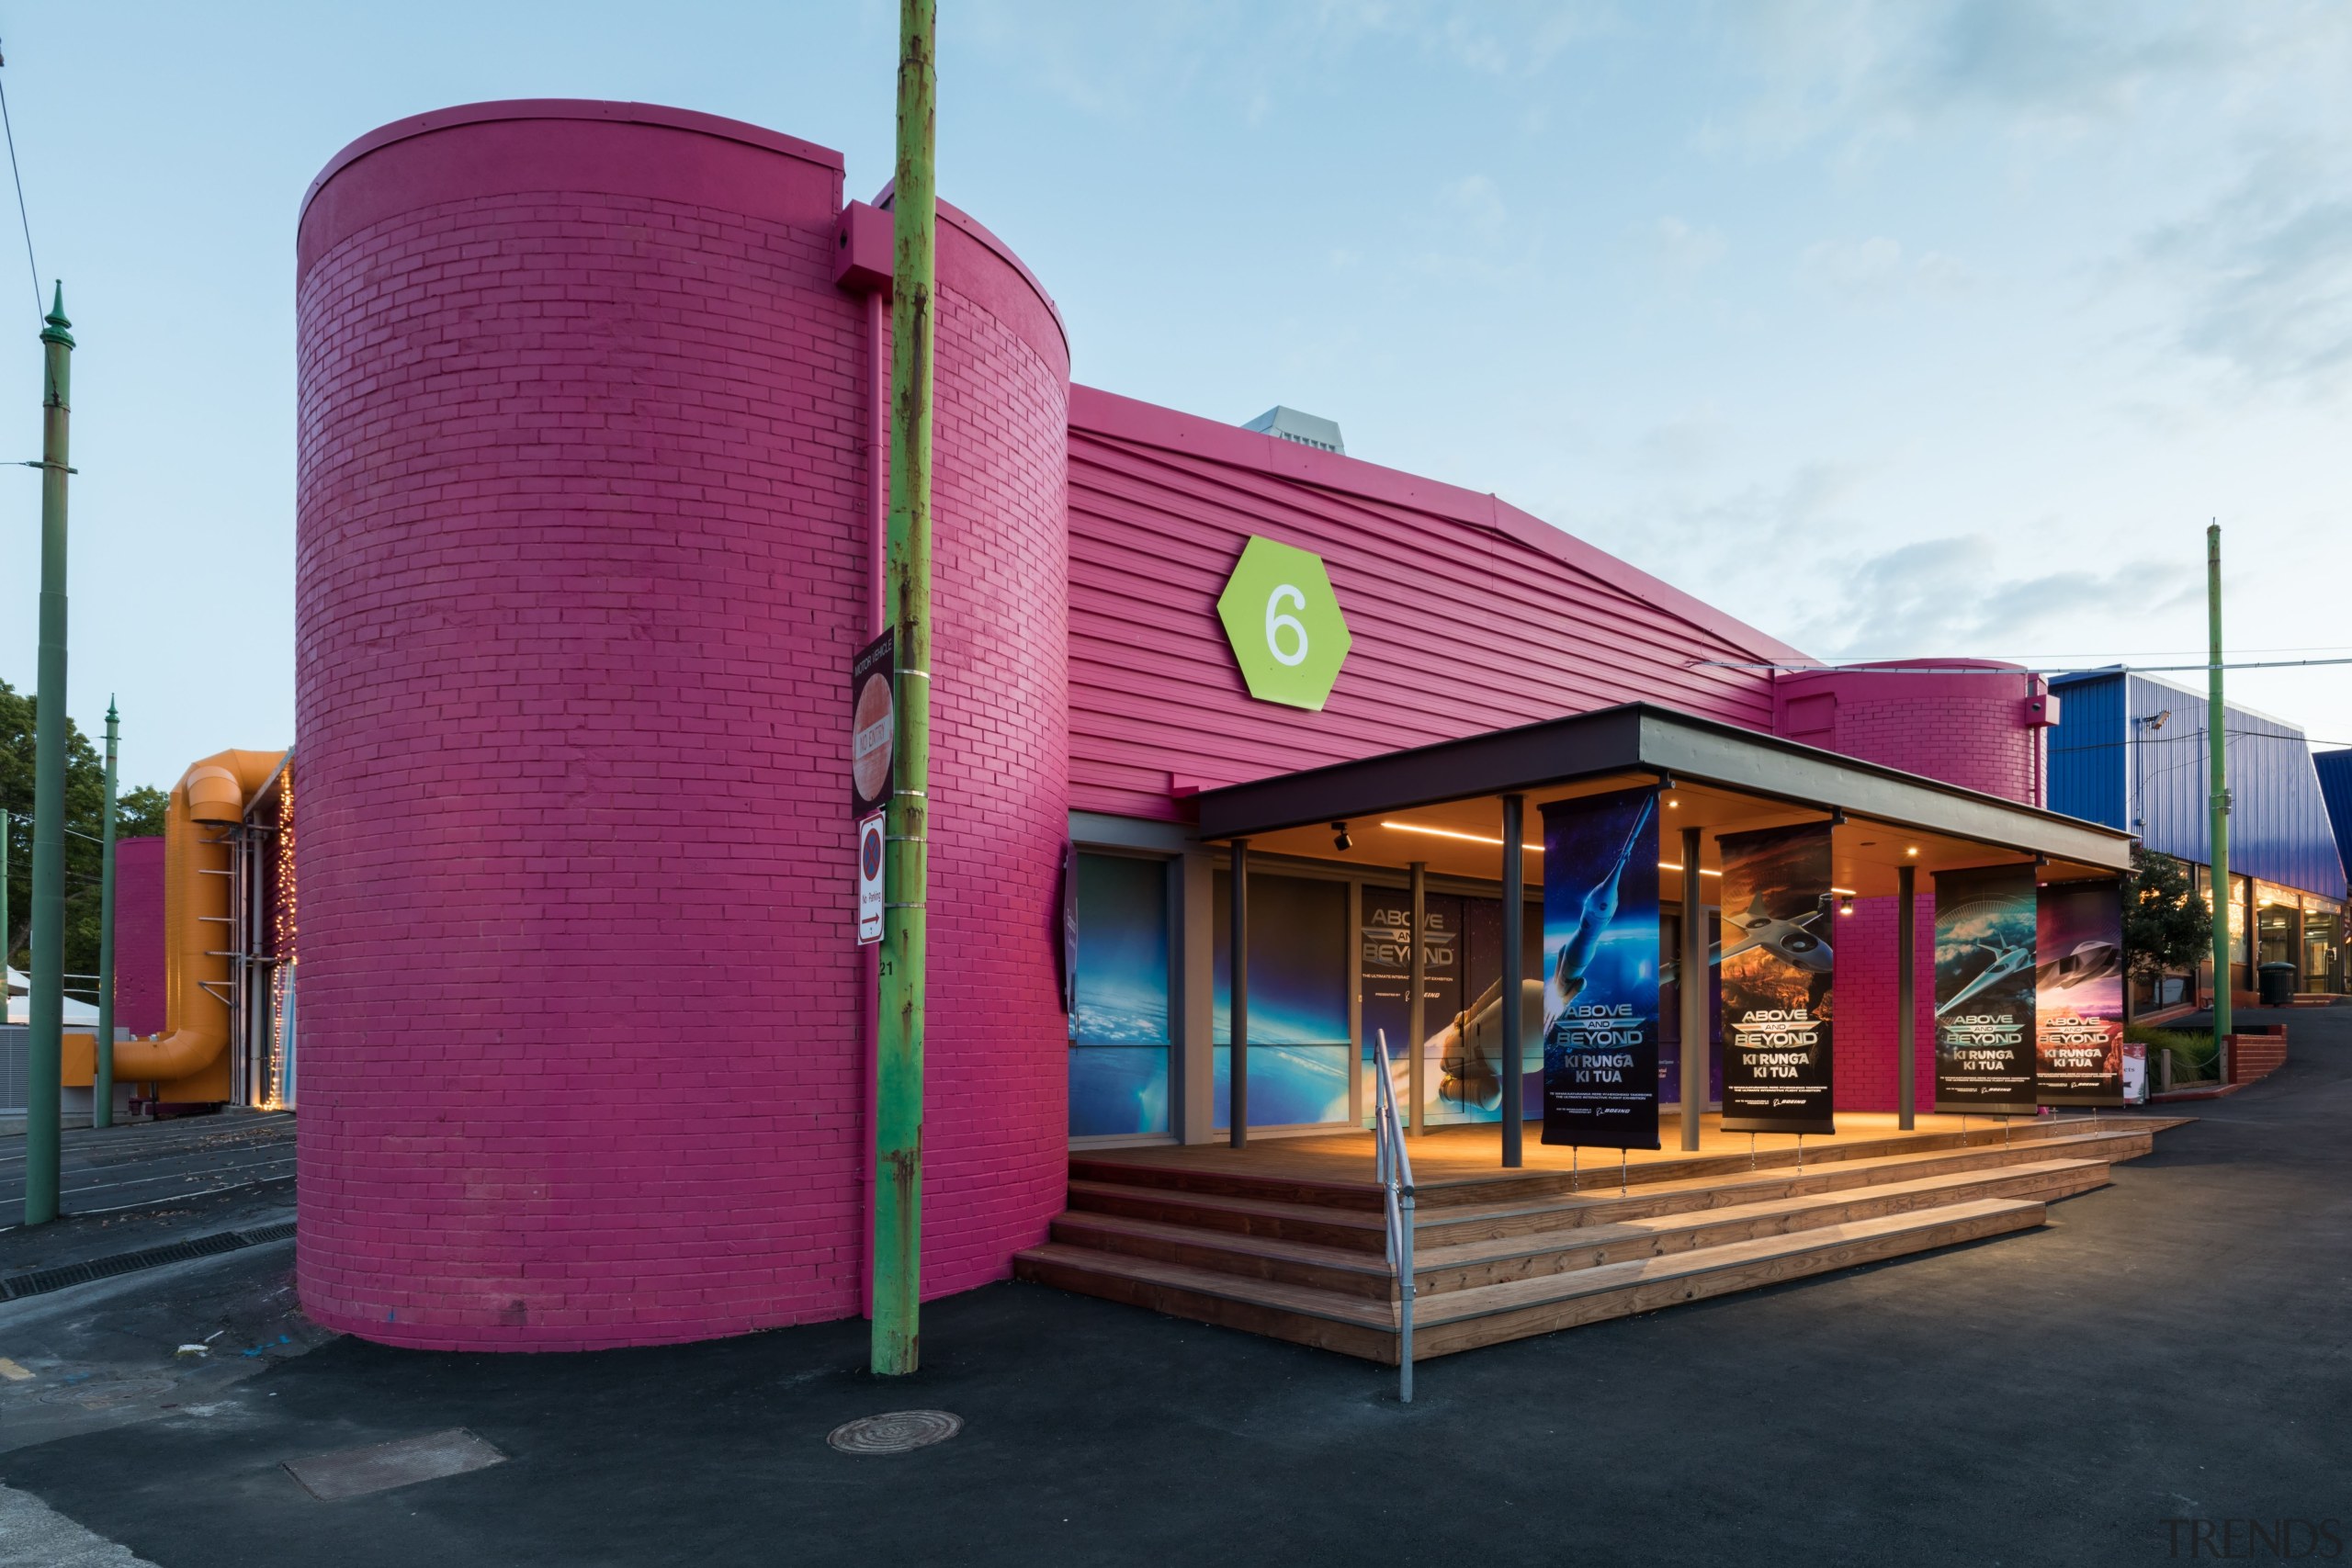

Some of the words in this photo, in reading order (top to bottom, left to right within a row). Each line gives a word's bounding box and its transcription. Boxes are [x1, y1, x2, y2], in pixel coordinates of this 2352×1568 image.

[1265, 583, 1308, 667] 6
[854, 655, 872, 677] MOTOR
[872, 637, 892, 662] VEHICLE
[860, 733, 867, 751] NO
[869, 721, 885, 747] ENTRY
[862, 894, 867, 904] No
[868, 890, 881, 903] Parking
[1363, 943, 1453, 964] BEYND
[1565, 1004, 1633, 1017] ABOVE
[1742, 1010, 1808, 1021] ABOVE
[1953, 1014, 2013, 1024] ABOVE
[2045, 1017, 2100, 1026] ABOVE
[1556, 1030, 1643, 1045] BEYOND
[1735, 1032, 1818, 1046] BEYOND
[1947, 1033, 2021, 1043] BEYOND
[2039, 1033, 2109, 1043] BEYOND
[1743, 1054, 1757, 1065] KI
[1759, 1053, 1810, 1066] RUNGA
[1953, 1050, 1965, 1060] KI
[1969, 1050, 2015, 1060] RUNGA
[2044, 1049, 2056, 1057] KI
[2059, 1049, 2102, 1057] RUNGA
[1565, 1055, 1578, 1067] KI
[1582, 1055, 1634, 1068] RUNGA
[1963, 1061, 1975, 1070] KI
[1978, 1061, 2004, 1070] TUA
[2053, 1058, 2066, 1067] KI
[2068, 1058, 2093, 1067] TUA
[1576, 1070, 1589, 1083] KI
[1593, 1070, 1623, 1083] TUA
[1753, 1066, 1767, 1077] KI
[1770, 1066, 1798, 1077] TUA
